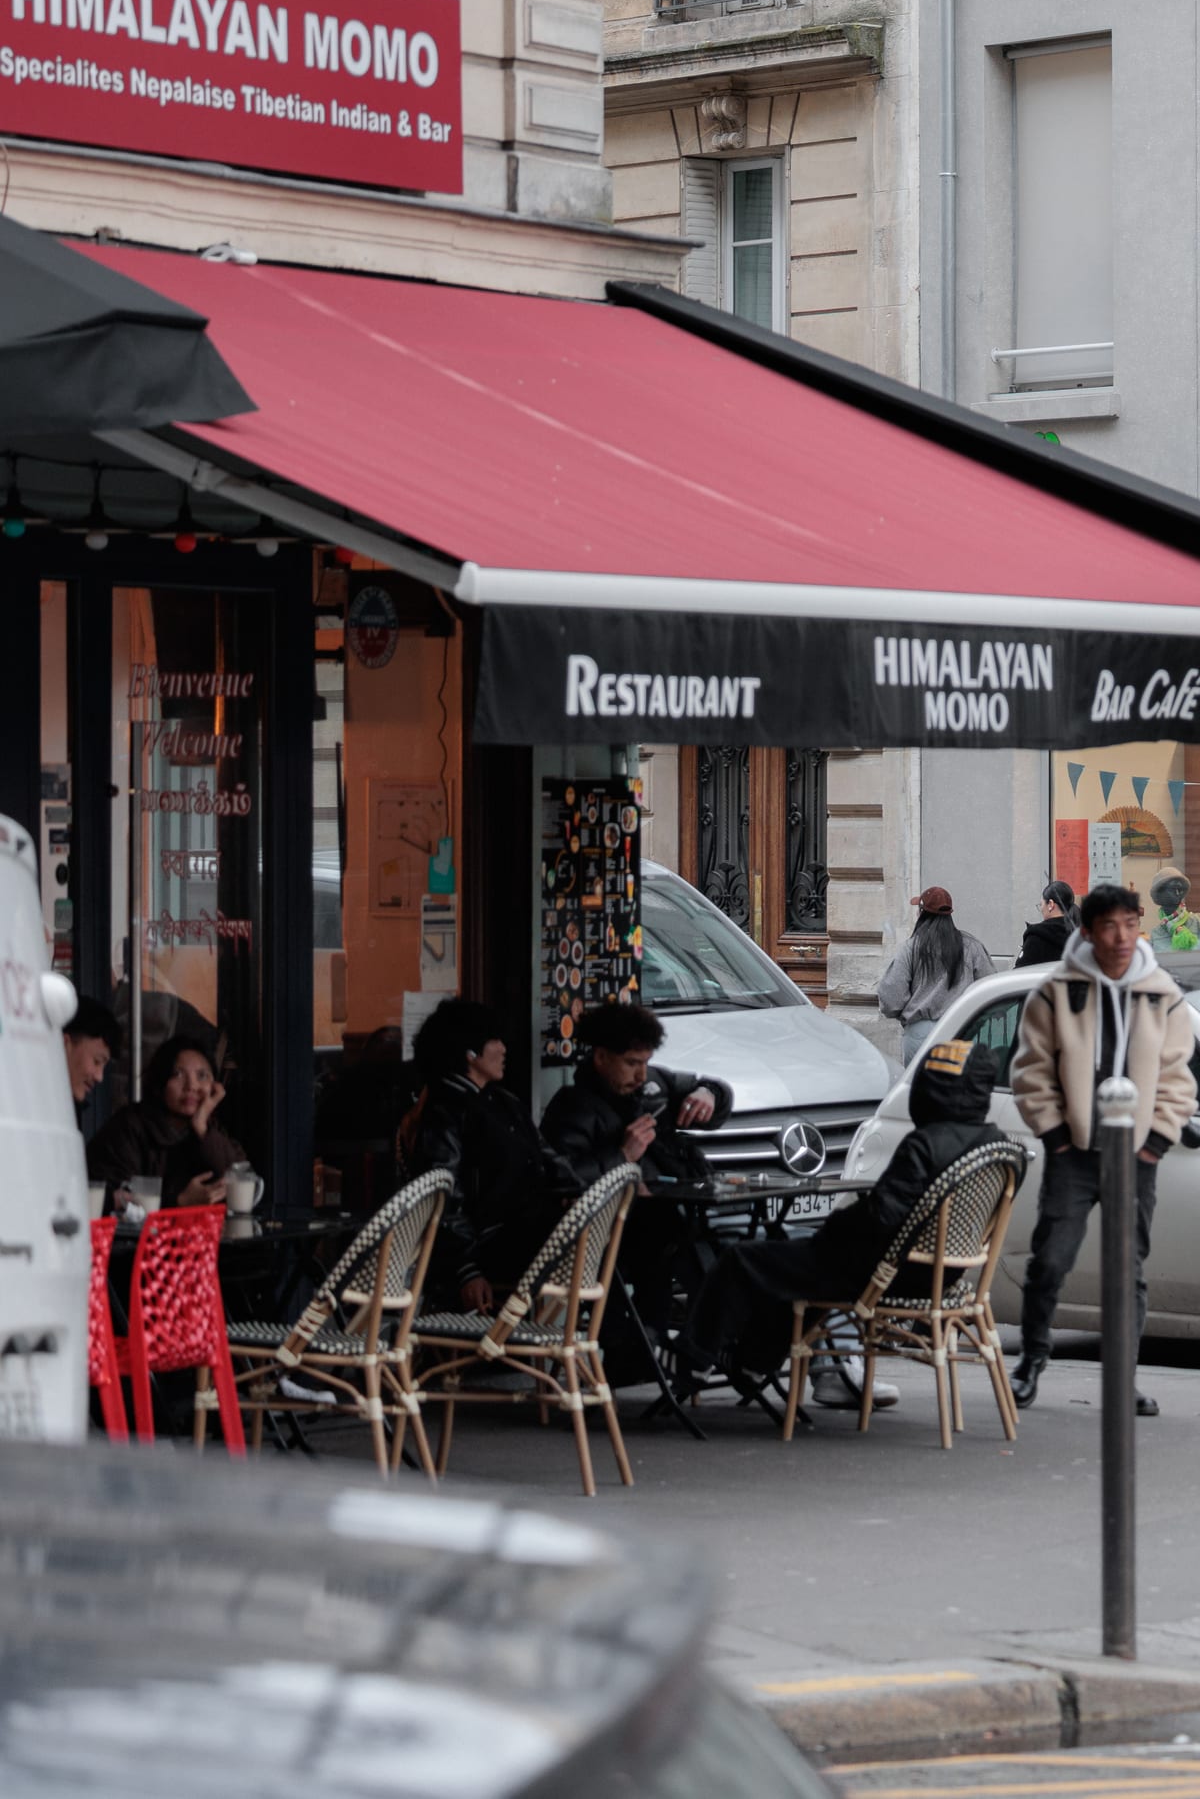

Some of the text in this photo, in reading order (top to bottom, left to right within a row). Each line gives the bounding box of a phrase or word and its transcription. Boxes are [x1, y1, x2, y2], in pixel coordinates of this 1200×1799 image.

[304, 12, 439, 88] MOMO
[0, 46, 451, 143] Specialites Nepalaise Tibetian Indian & Bar
[128, 663, 254, 698] Bienvenue
[874, 636, 1053, 691] HIMALAYAN
[924, 690, 1009, 732] MOMO
[142, 720, 243, 758] Welcome
